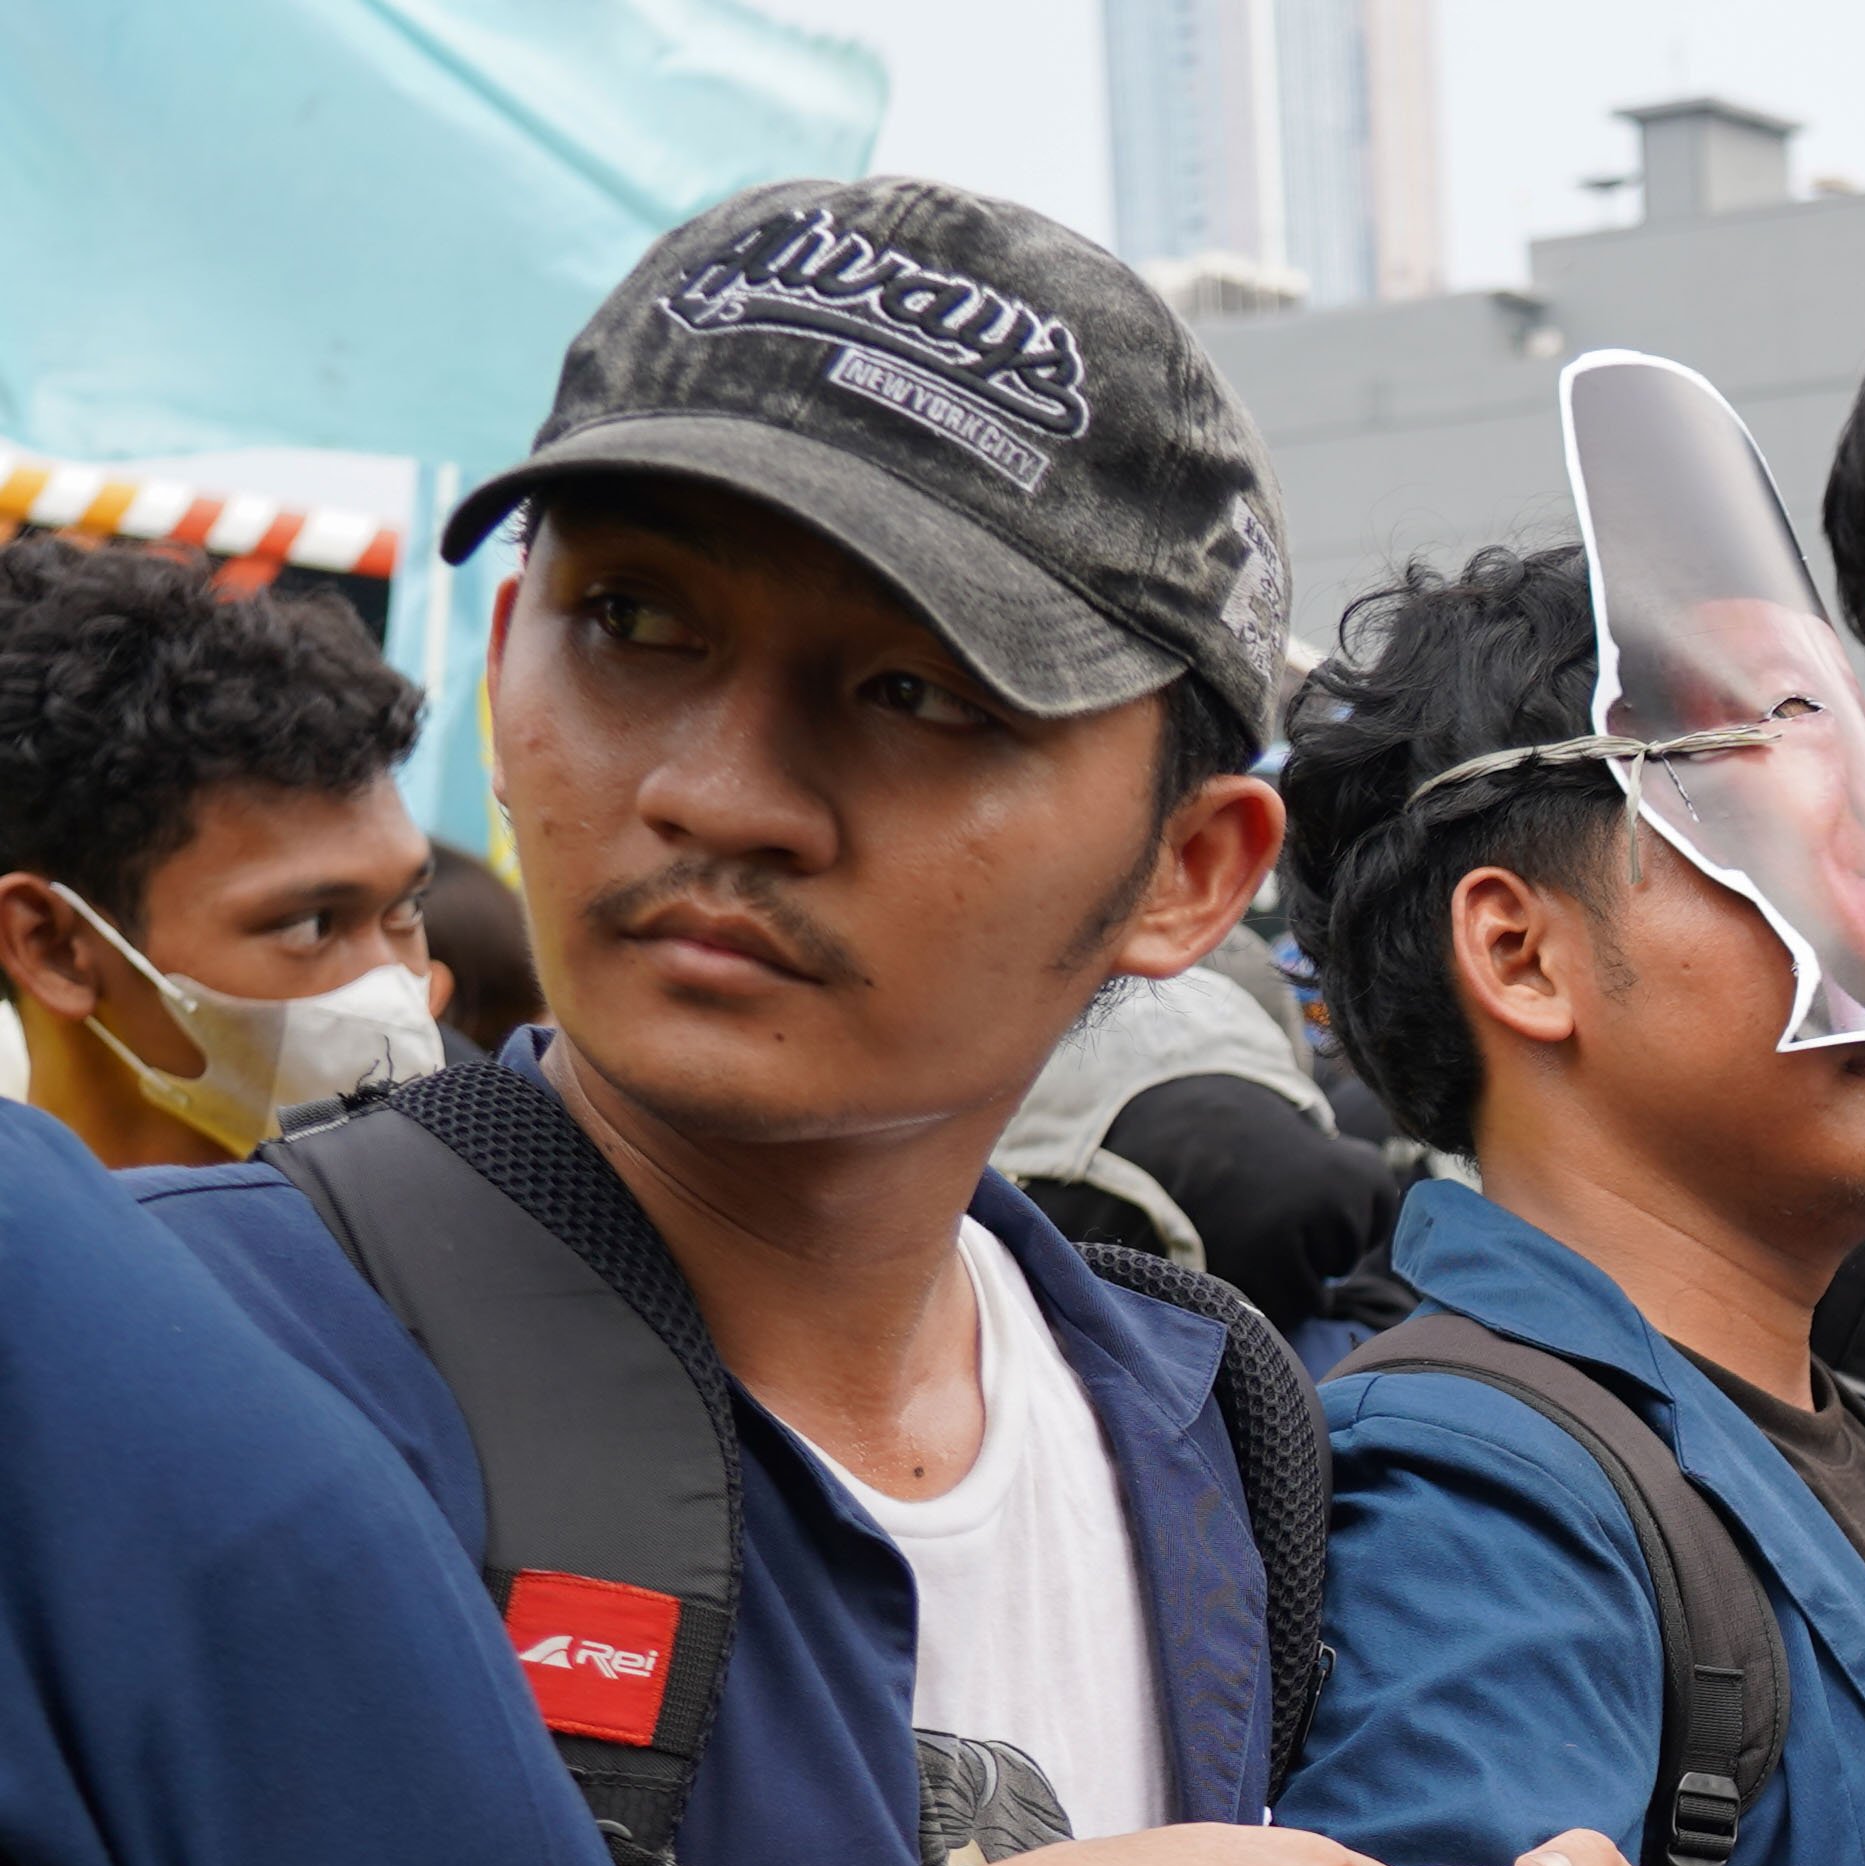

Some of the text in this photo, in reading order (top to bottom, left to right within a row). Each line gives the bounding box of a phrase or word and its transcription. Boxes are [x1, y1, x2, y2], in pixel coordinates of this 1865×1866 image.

[844, 357, 1037, 477] NEW YORK CITY
